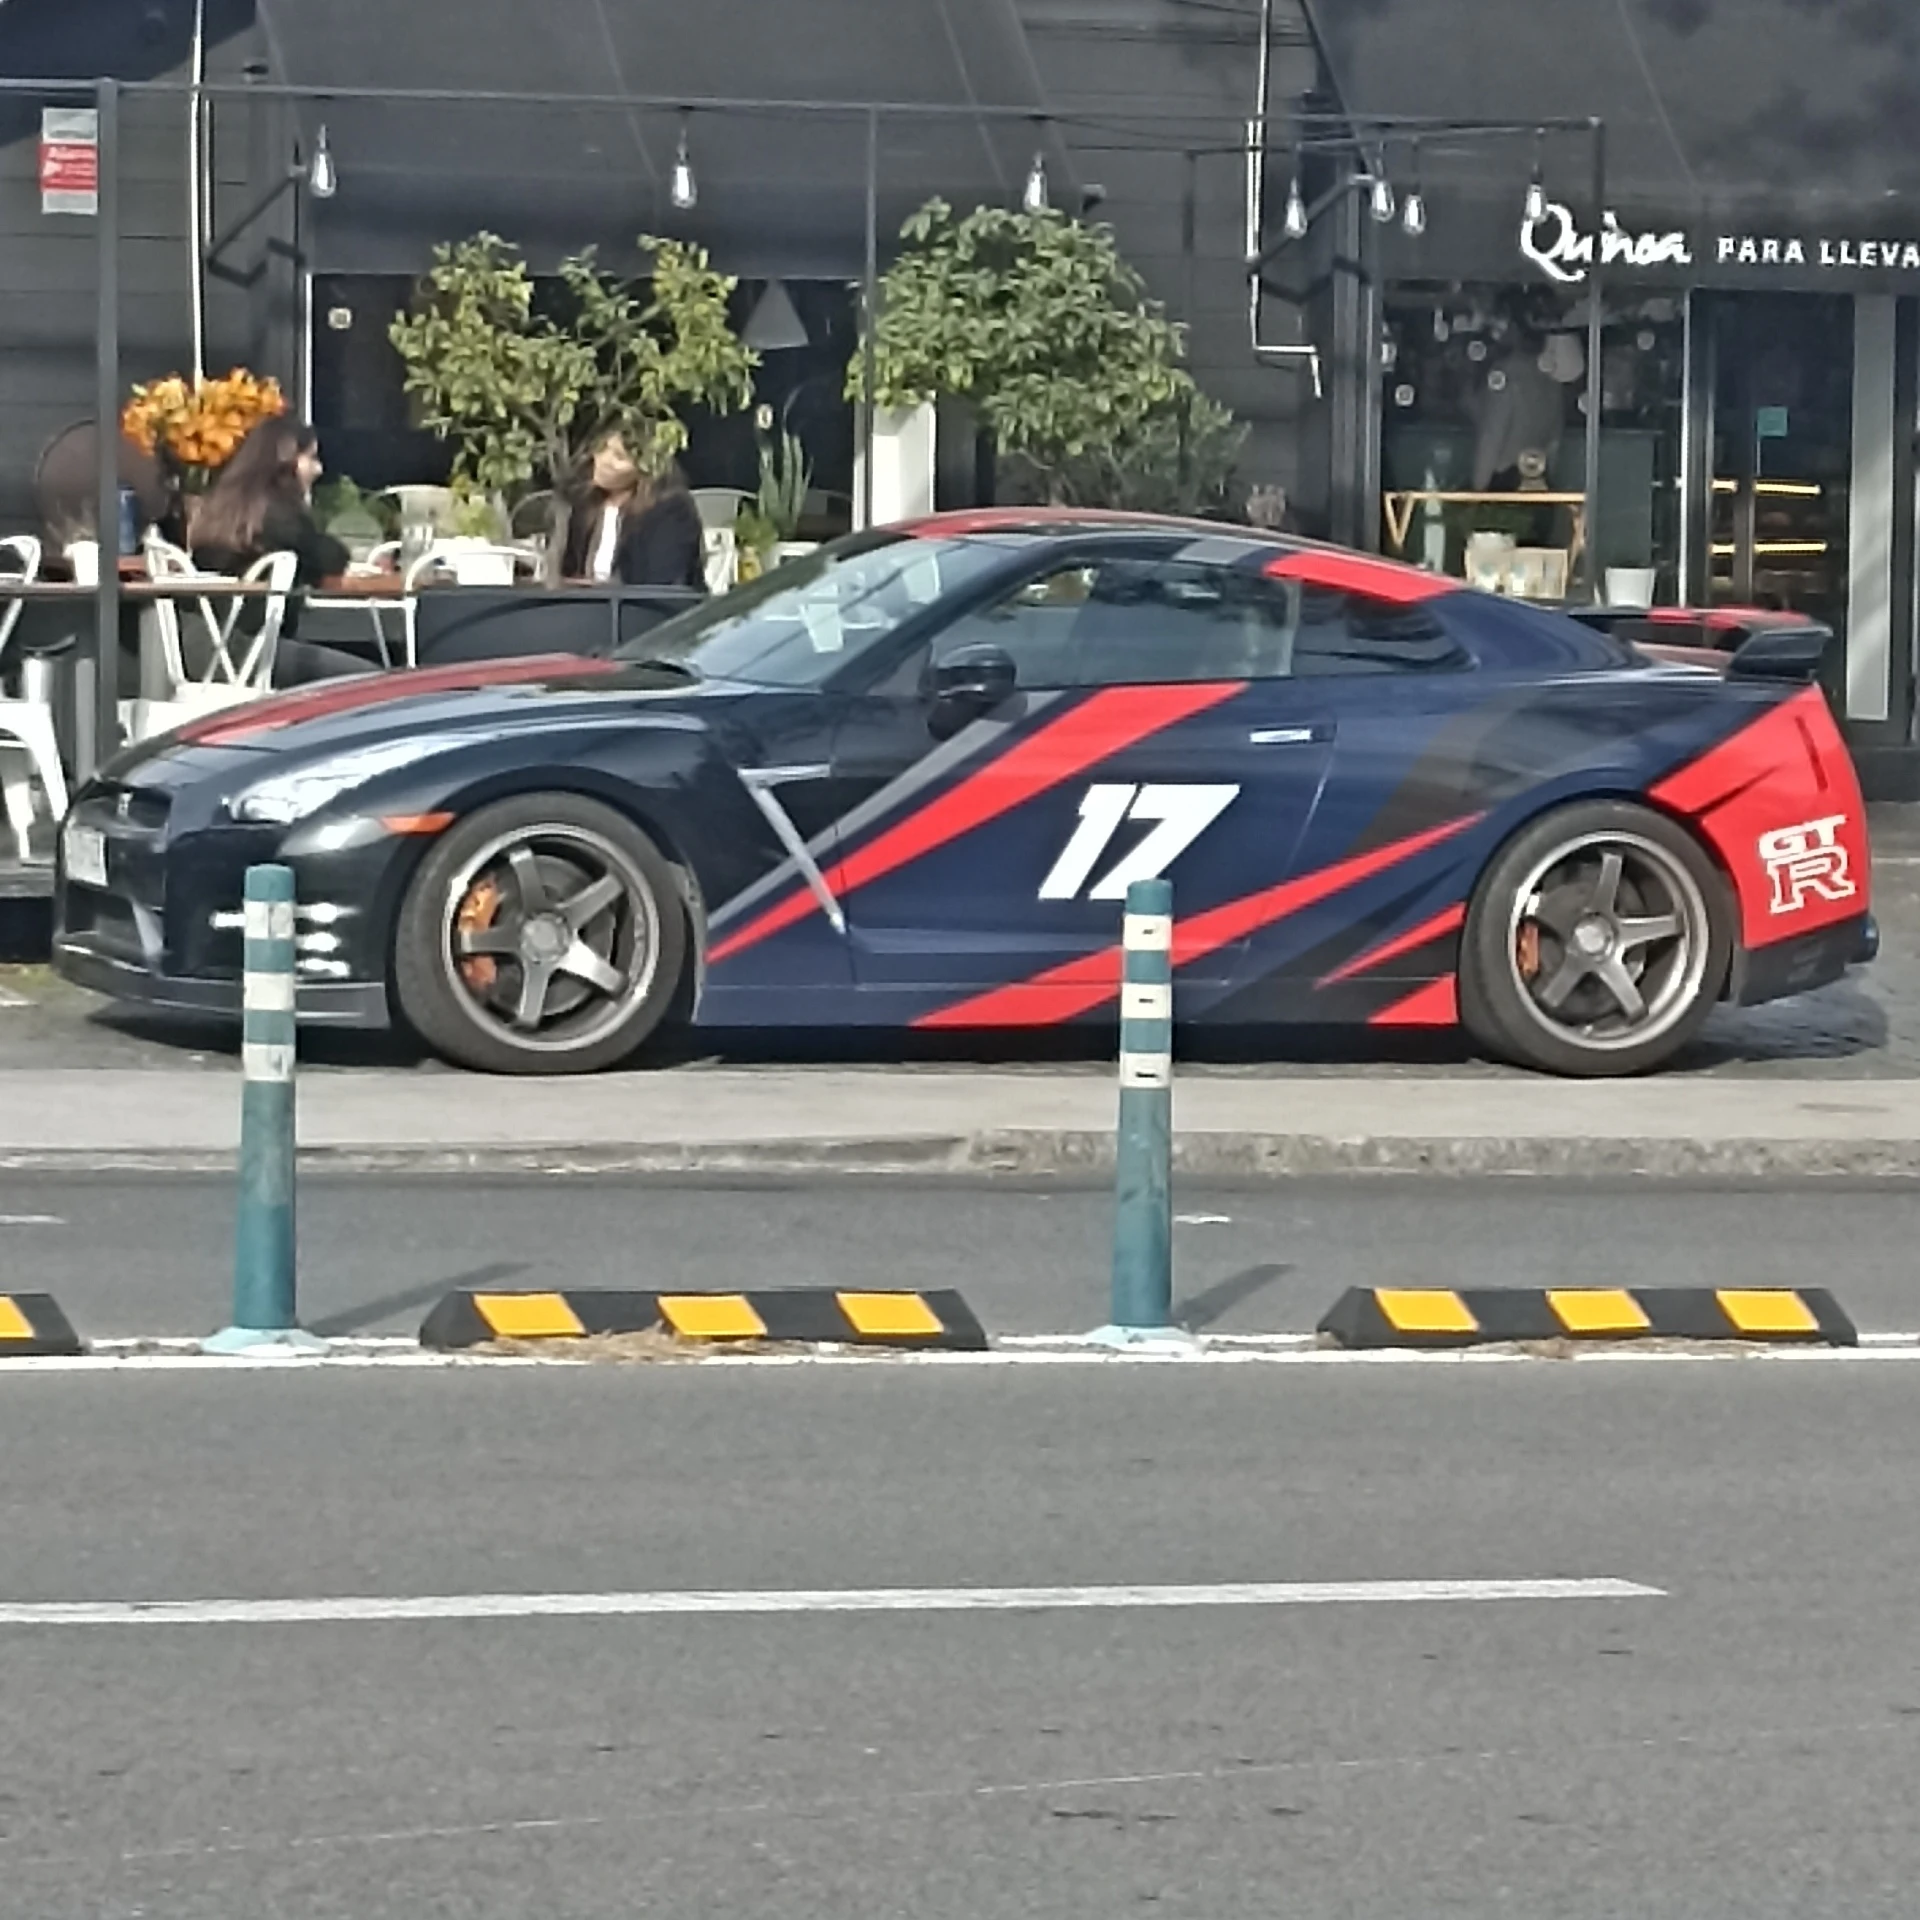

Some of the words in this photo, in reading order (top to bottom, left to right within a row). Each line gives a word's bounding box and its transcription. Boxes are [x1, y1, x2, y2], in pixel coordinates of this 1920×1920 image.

[1717, 236, 1805, 264] PARA
[1820, 238, 1920, 269] LLEVA
[1038, 783, 1241, 900] 17
